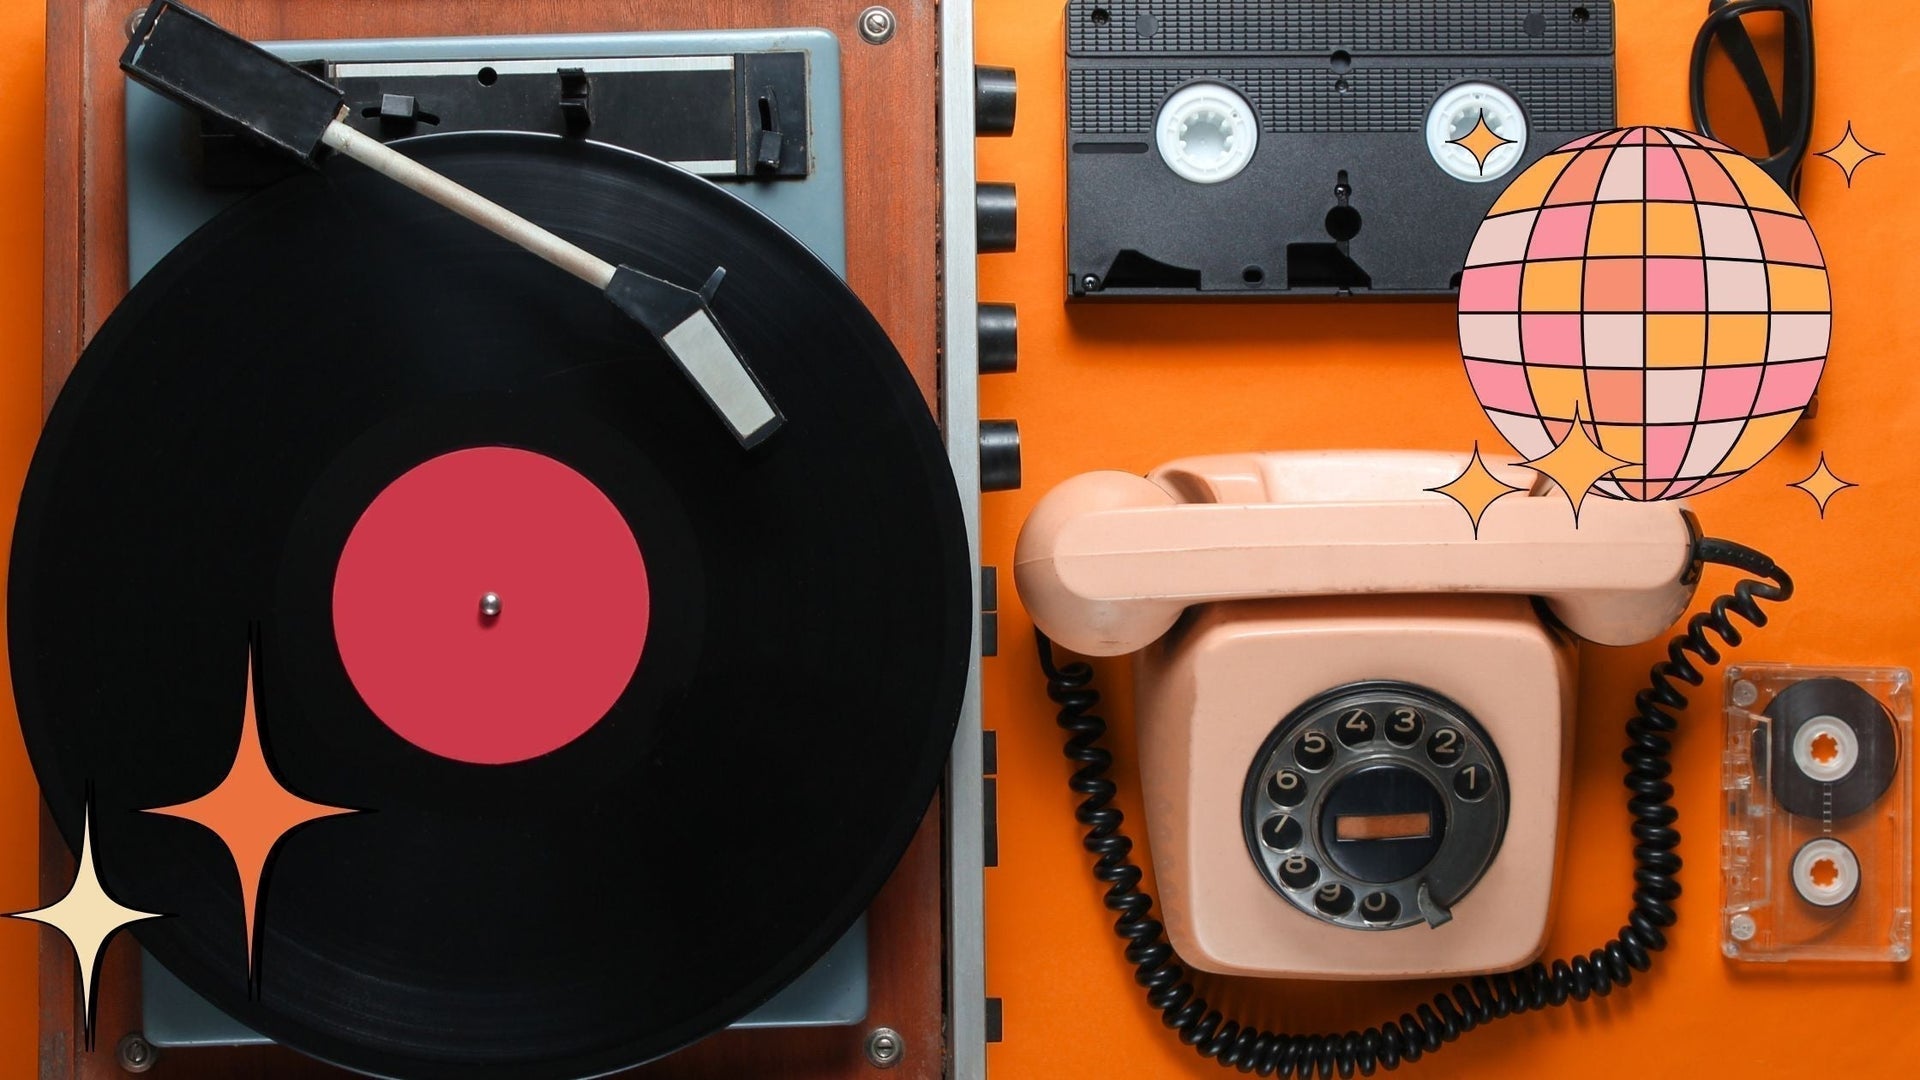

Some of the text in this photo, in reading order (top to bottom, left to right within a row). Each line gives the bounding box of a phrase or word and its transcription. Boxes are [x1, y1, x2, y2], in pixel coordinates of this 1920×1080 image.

[1345, 709, 1368, 732] 4
[1394, 707, 1415, 732] 3
[1304, 732, 1326, 753] 5
[1435, 729, 1457, 753] 2
[1276, 770, 1298, 790] 6
[1462, 766, 1476, 790] 1
[1285, 856, 1307, 874] 8
